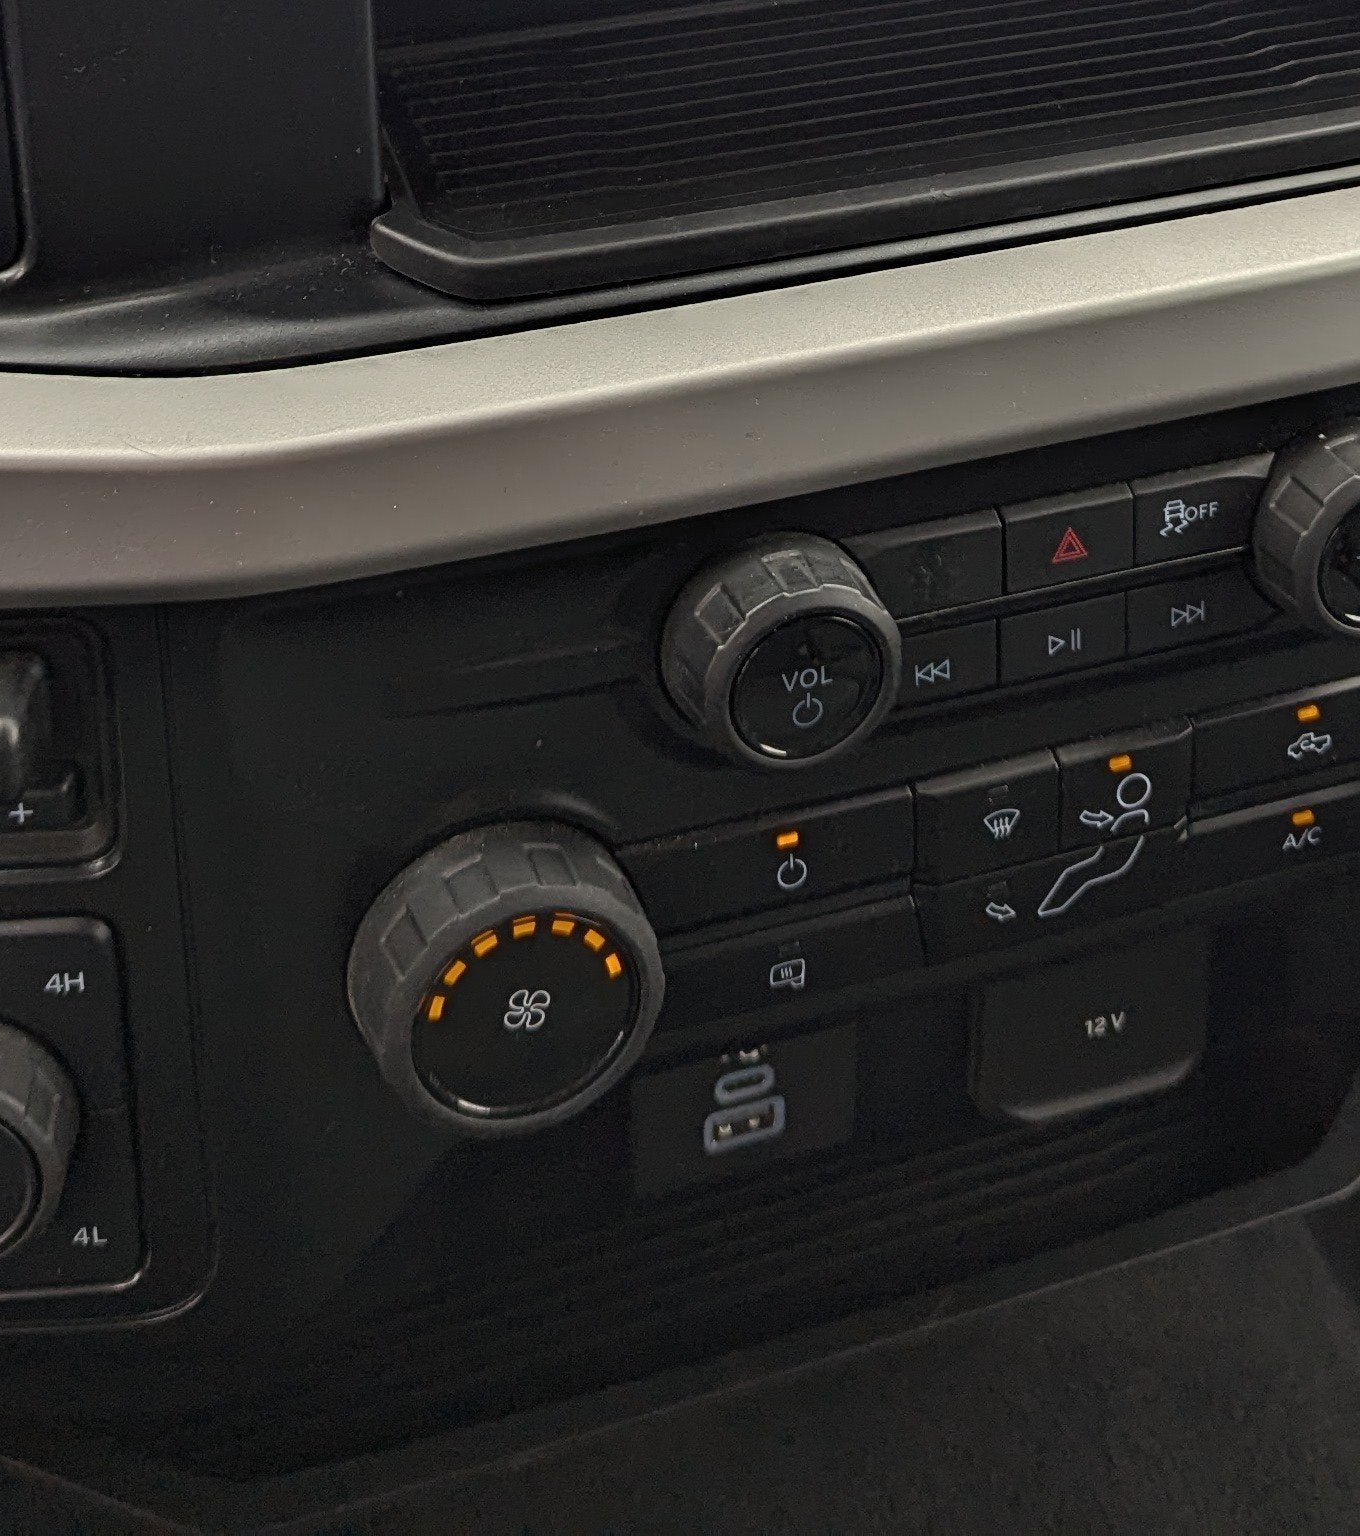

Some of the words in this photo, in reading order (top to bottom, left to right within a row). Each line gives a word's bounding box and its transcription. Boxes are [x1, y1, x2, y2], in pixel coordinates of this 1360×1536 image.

[1185, 501, 1219, 522] OFF
[781, 665, 834, 692] VOL
[1282, 825, 1323, 851] A/C
[45, 971, 86, 995] 4H
[73, 1227, 109, 1246] 4L
